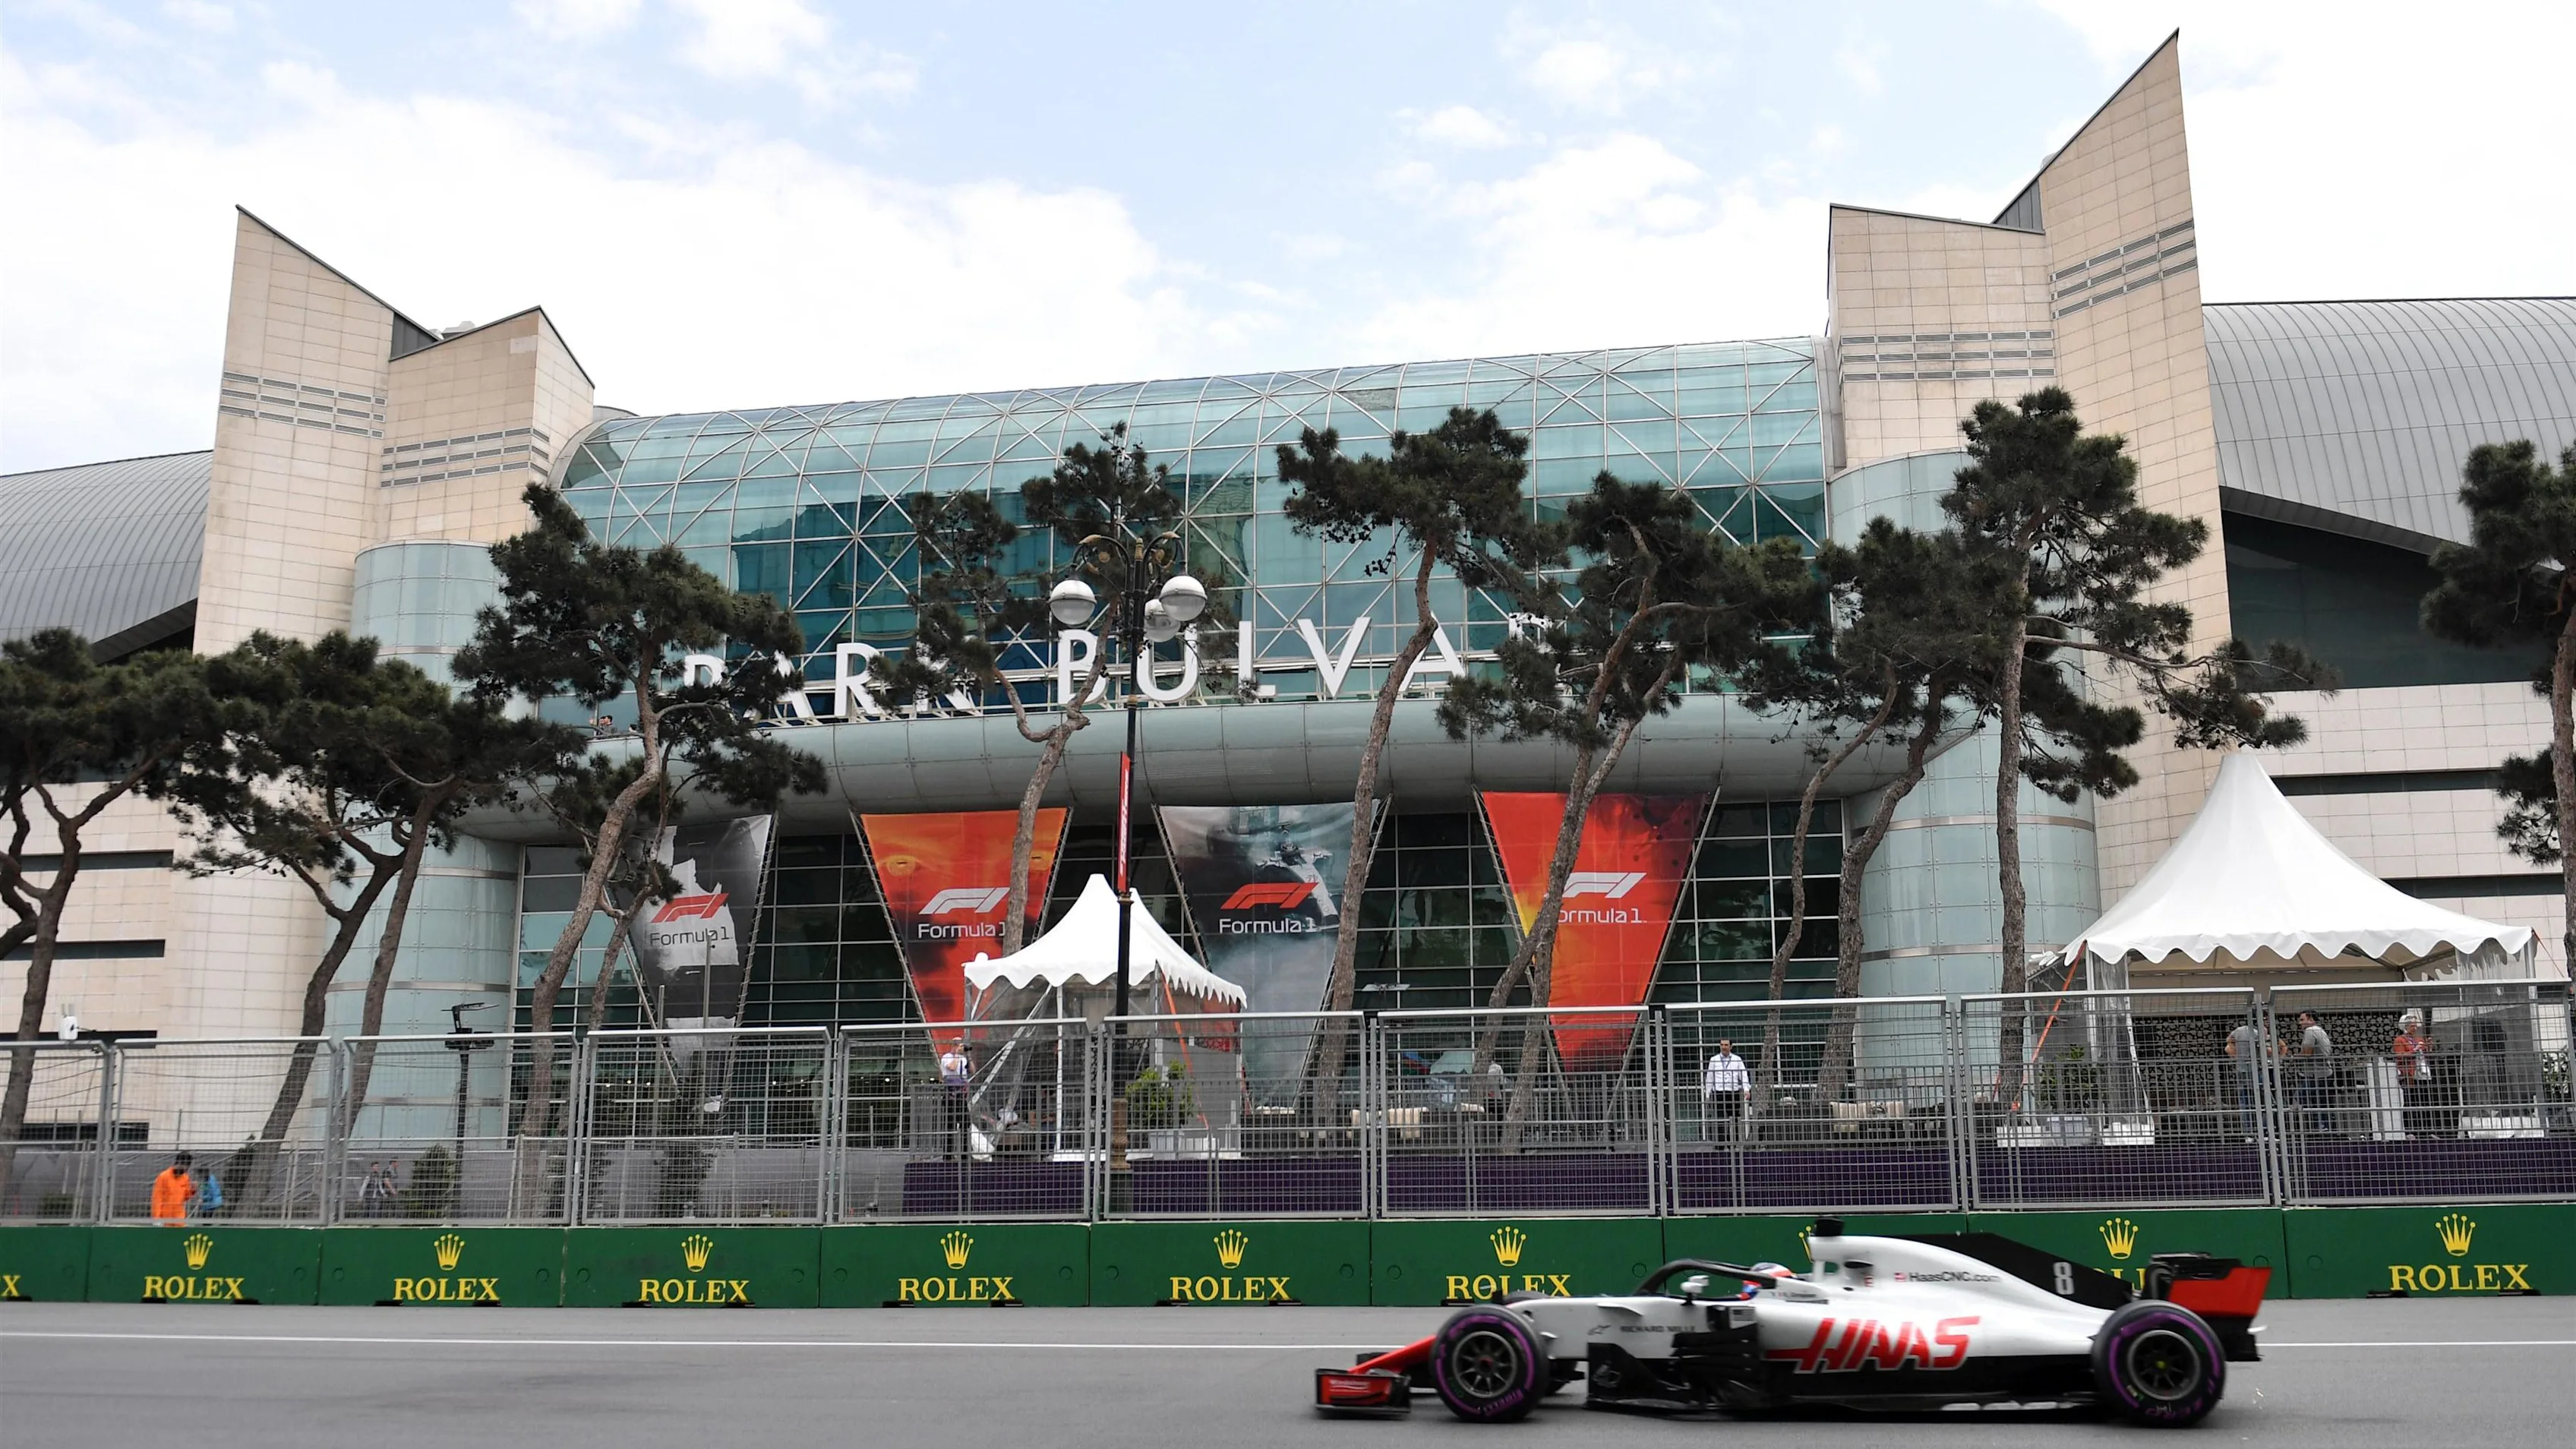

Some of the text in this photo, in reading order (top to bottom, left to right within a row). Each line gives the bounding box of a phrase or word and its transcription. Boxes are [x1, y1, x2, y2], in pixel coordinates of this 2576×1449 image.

[1558, 908, 1627, 923] ormula
[143, 1275, 244, 1299] ROLEX
[393, 1277, 499, 1301] ROLEX
[898, 1277, 1015, 1301] ROLEX
[1170, 1276, 1290, 1301] ROLEX
[1908, 1271, 2001, 1283] HaasCNC.com
[2054, 1261, 2075, 1296] 8
[2388, 1264, 2532, 1291] ROLEX
[639, 1279, 749, 1303] ROLEX
